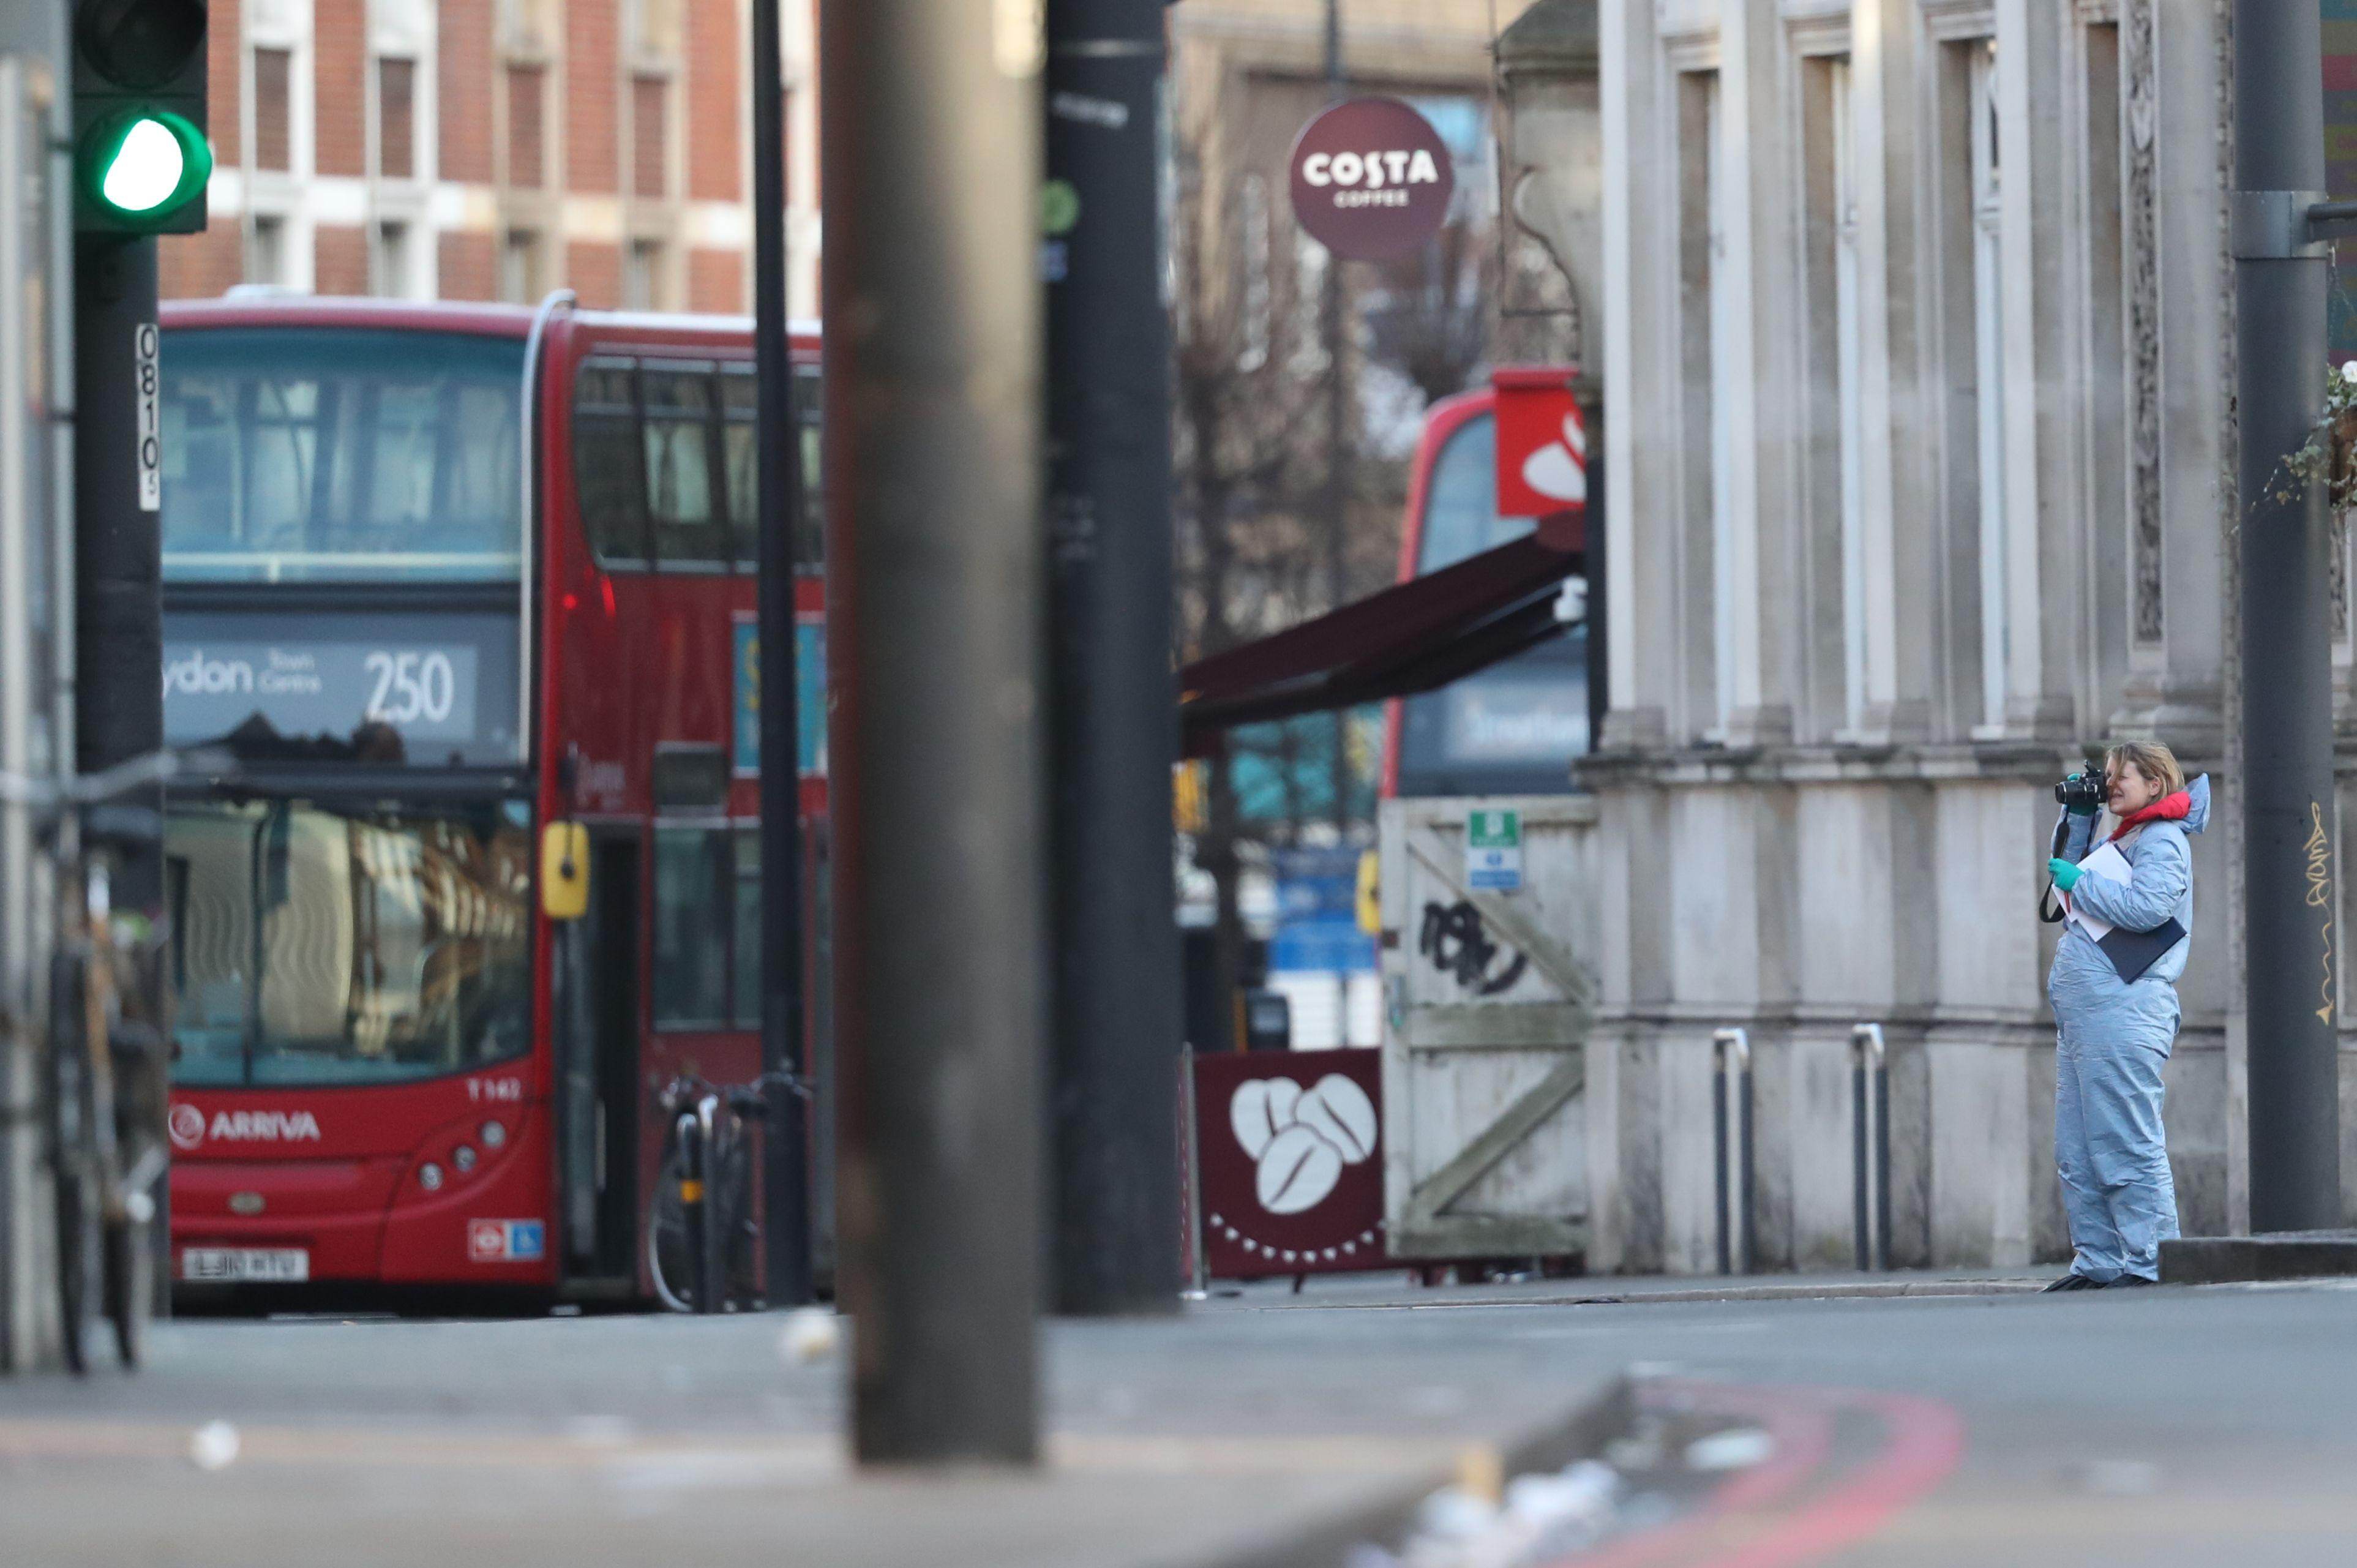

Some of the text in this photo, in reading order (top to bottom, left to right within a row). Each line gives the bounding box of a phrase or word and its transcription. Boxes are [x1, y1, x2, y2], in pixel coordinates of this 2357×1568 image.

[1302, 150, 1439, 189] COSTA
[1333, 189, 1409, 208] COFFEE
[364, 650, 455, 723] 250
[209, 1110, 321, 1142] ARRIVA
